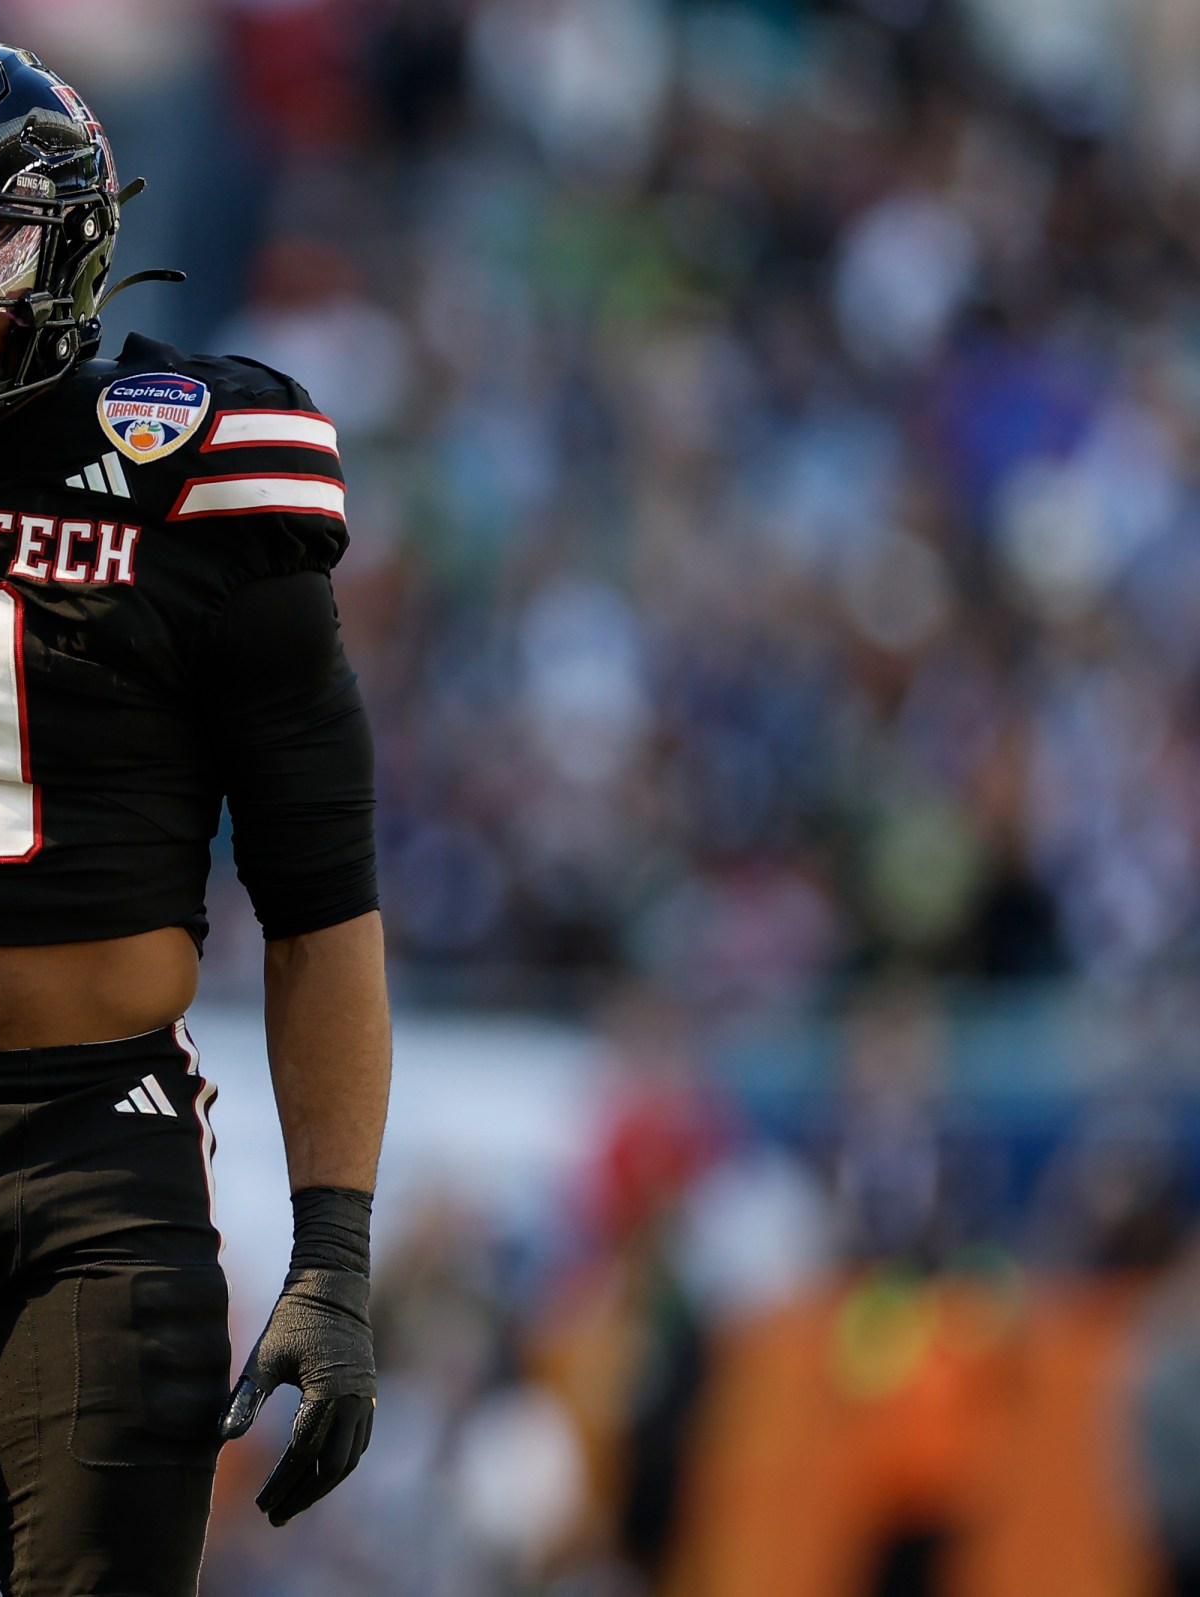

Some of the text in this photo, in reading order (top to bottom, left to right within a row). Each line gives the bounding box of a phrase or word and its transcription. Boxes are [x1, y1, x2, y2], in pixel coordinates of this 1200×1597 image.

[16, 176, 50, 190] GUNS UP
[106, 402, 190, 427] ORANGE BOWL
